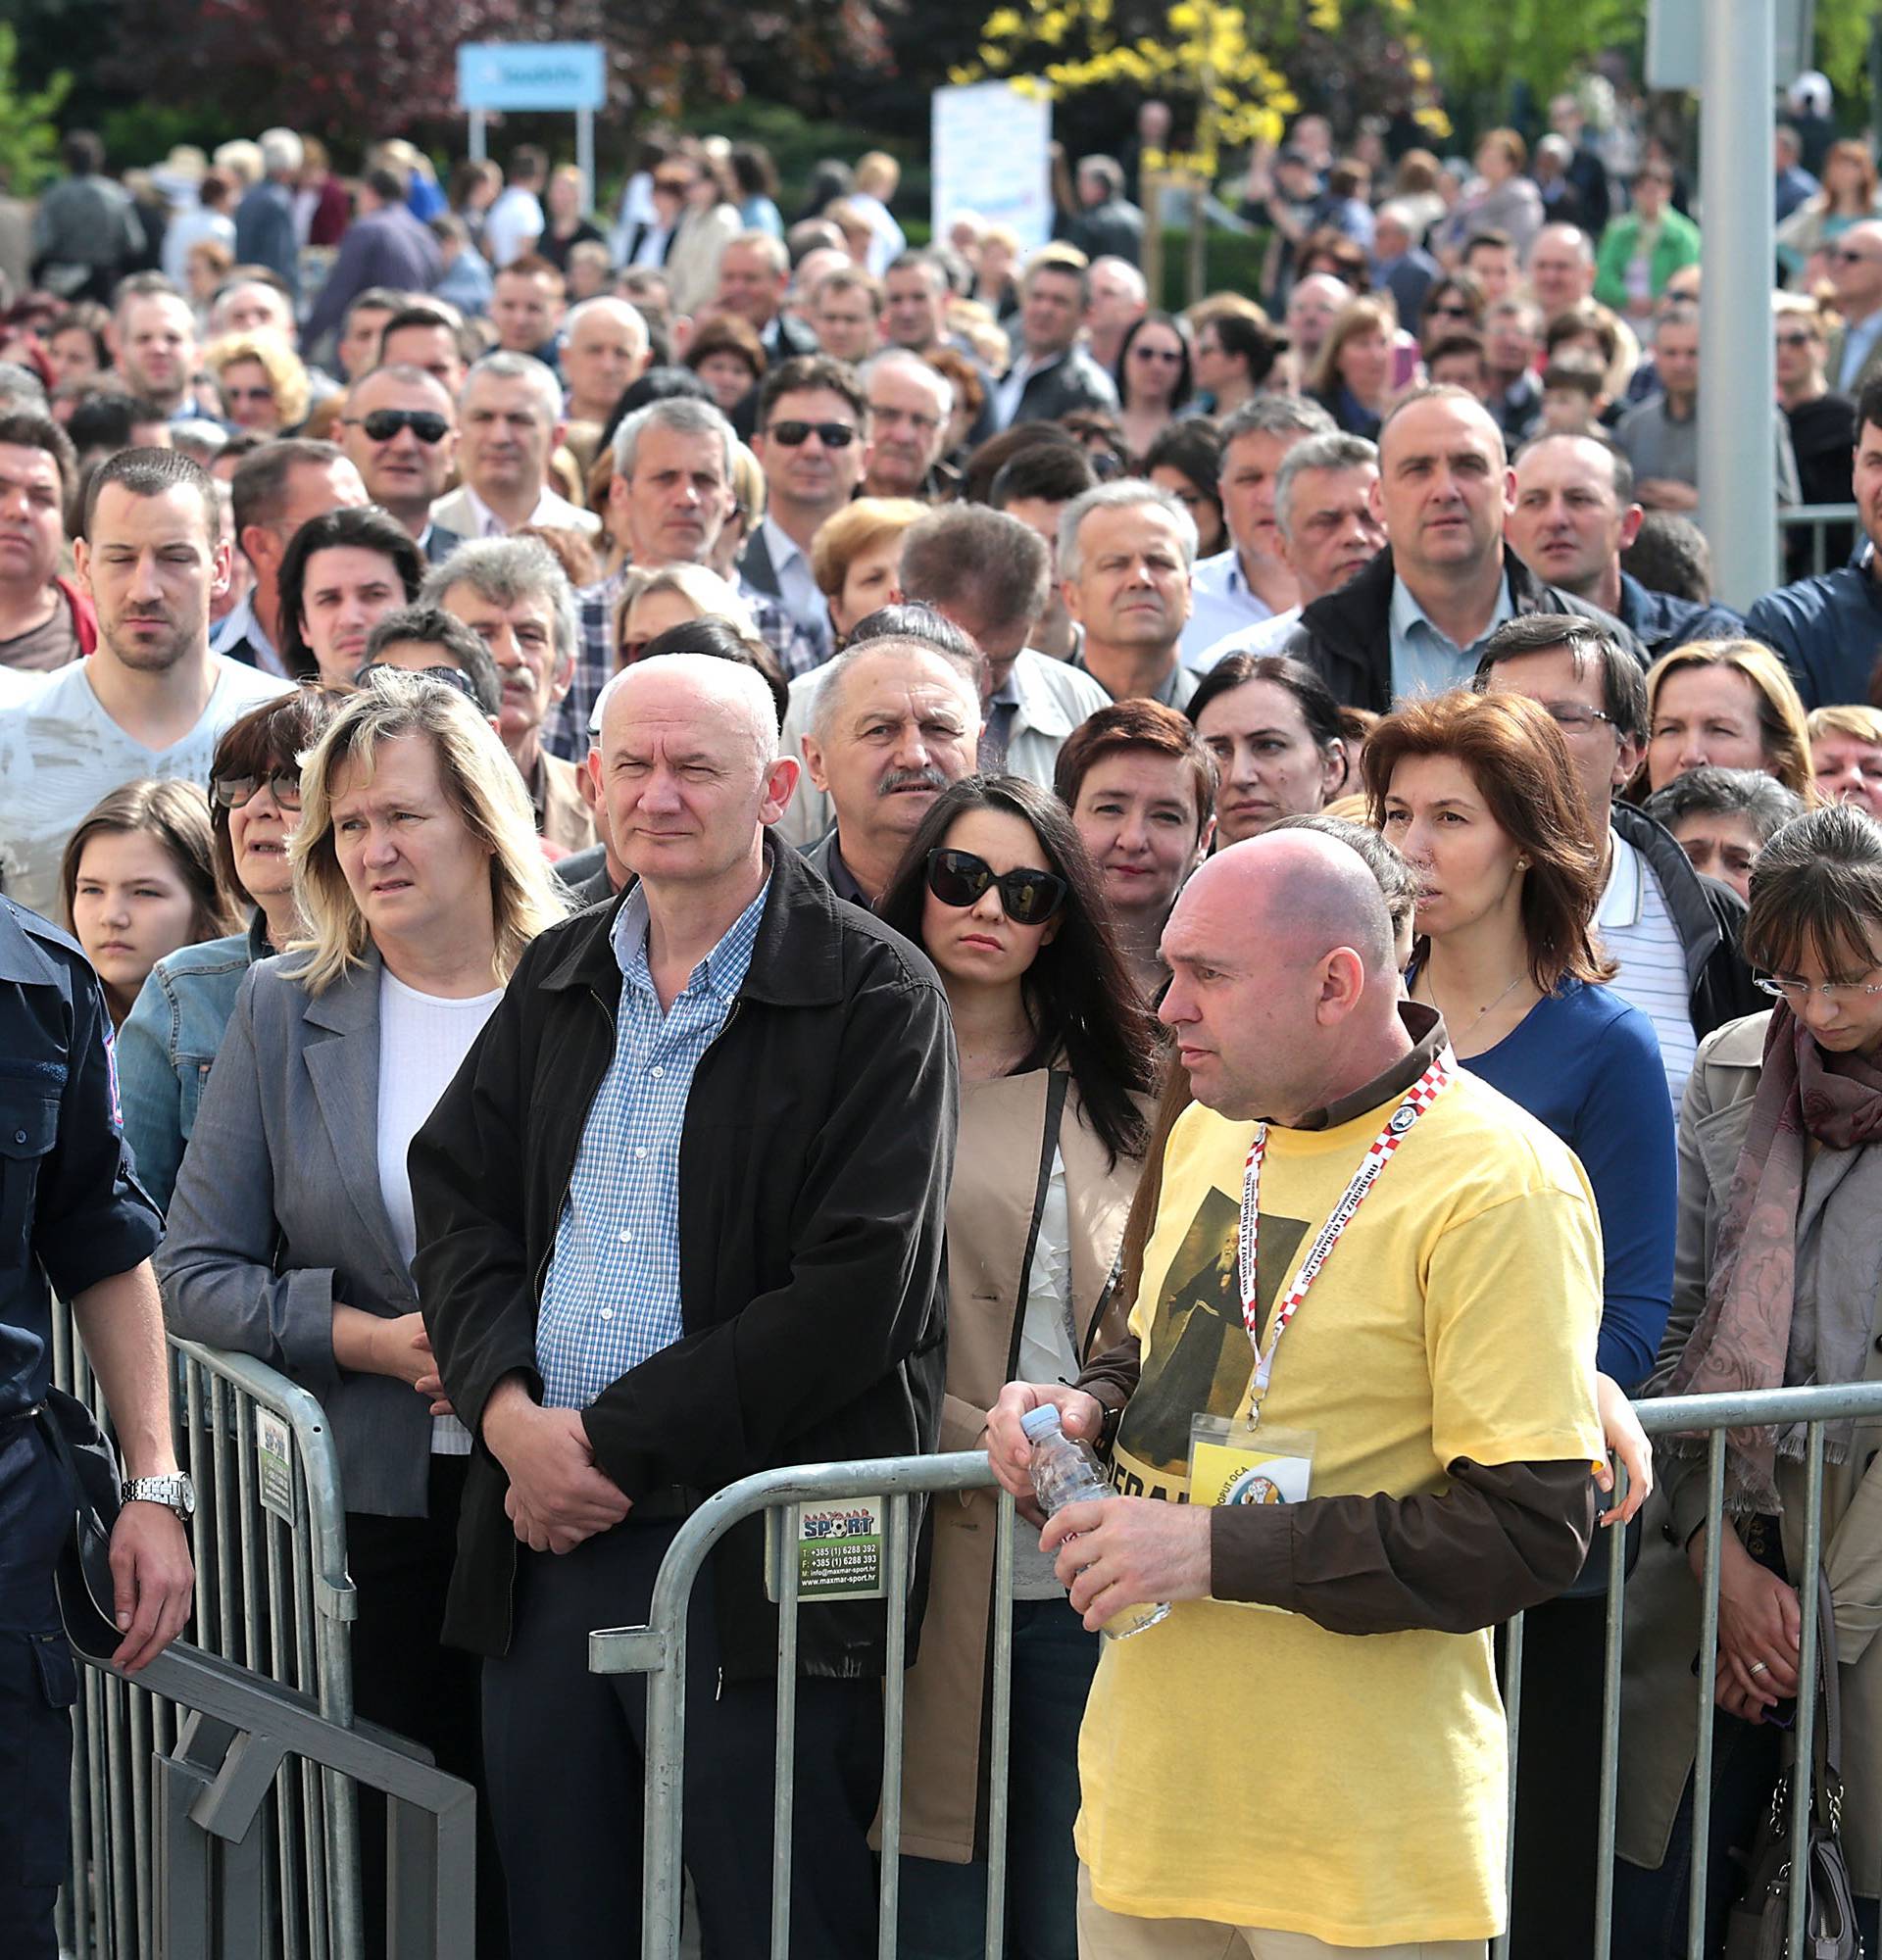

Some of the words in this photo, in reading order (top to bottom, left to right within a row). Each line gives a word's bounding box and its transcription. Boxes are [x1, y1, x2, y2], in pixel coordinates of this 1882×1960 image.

[1339, 1213, 1348, 1222] U
[1346, 1163, 1379, 1211] ZAGREBU
[1229, 1465, 1250, 1482] OCA
[804, 1517, 872, 1539] SPORT
[812, 1547, 829, 1556] +385
[830, 1546, 841, 1556] (1)
[843, 1545, 861, 1554] 6288
[863, 1544, 876, 1552] 392
[812, 1558, 830, 1567] +385
[831, 1557, 842, 1567] (1)
[843, 1556, 862, 1565] 6288
[864, 1554, 876, 1563] 393
[811, 1565, 876, 1577] info@maxmar-sport.hr
[802, 1574, 876, 1586] www.maxmar-sport.hr
